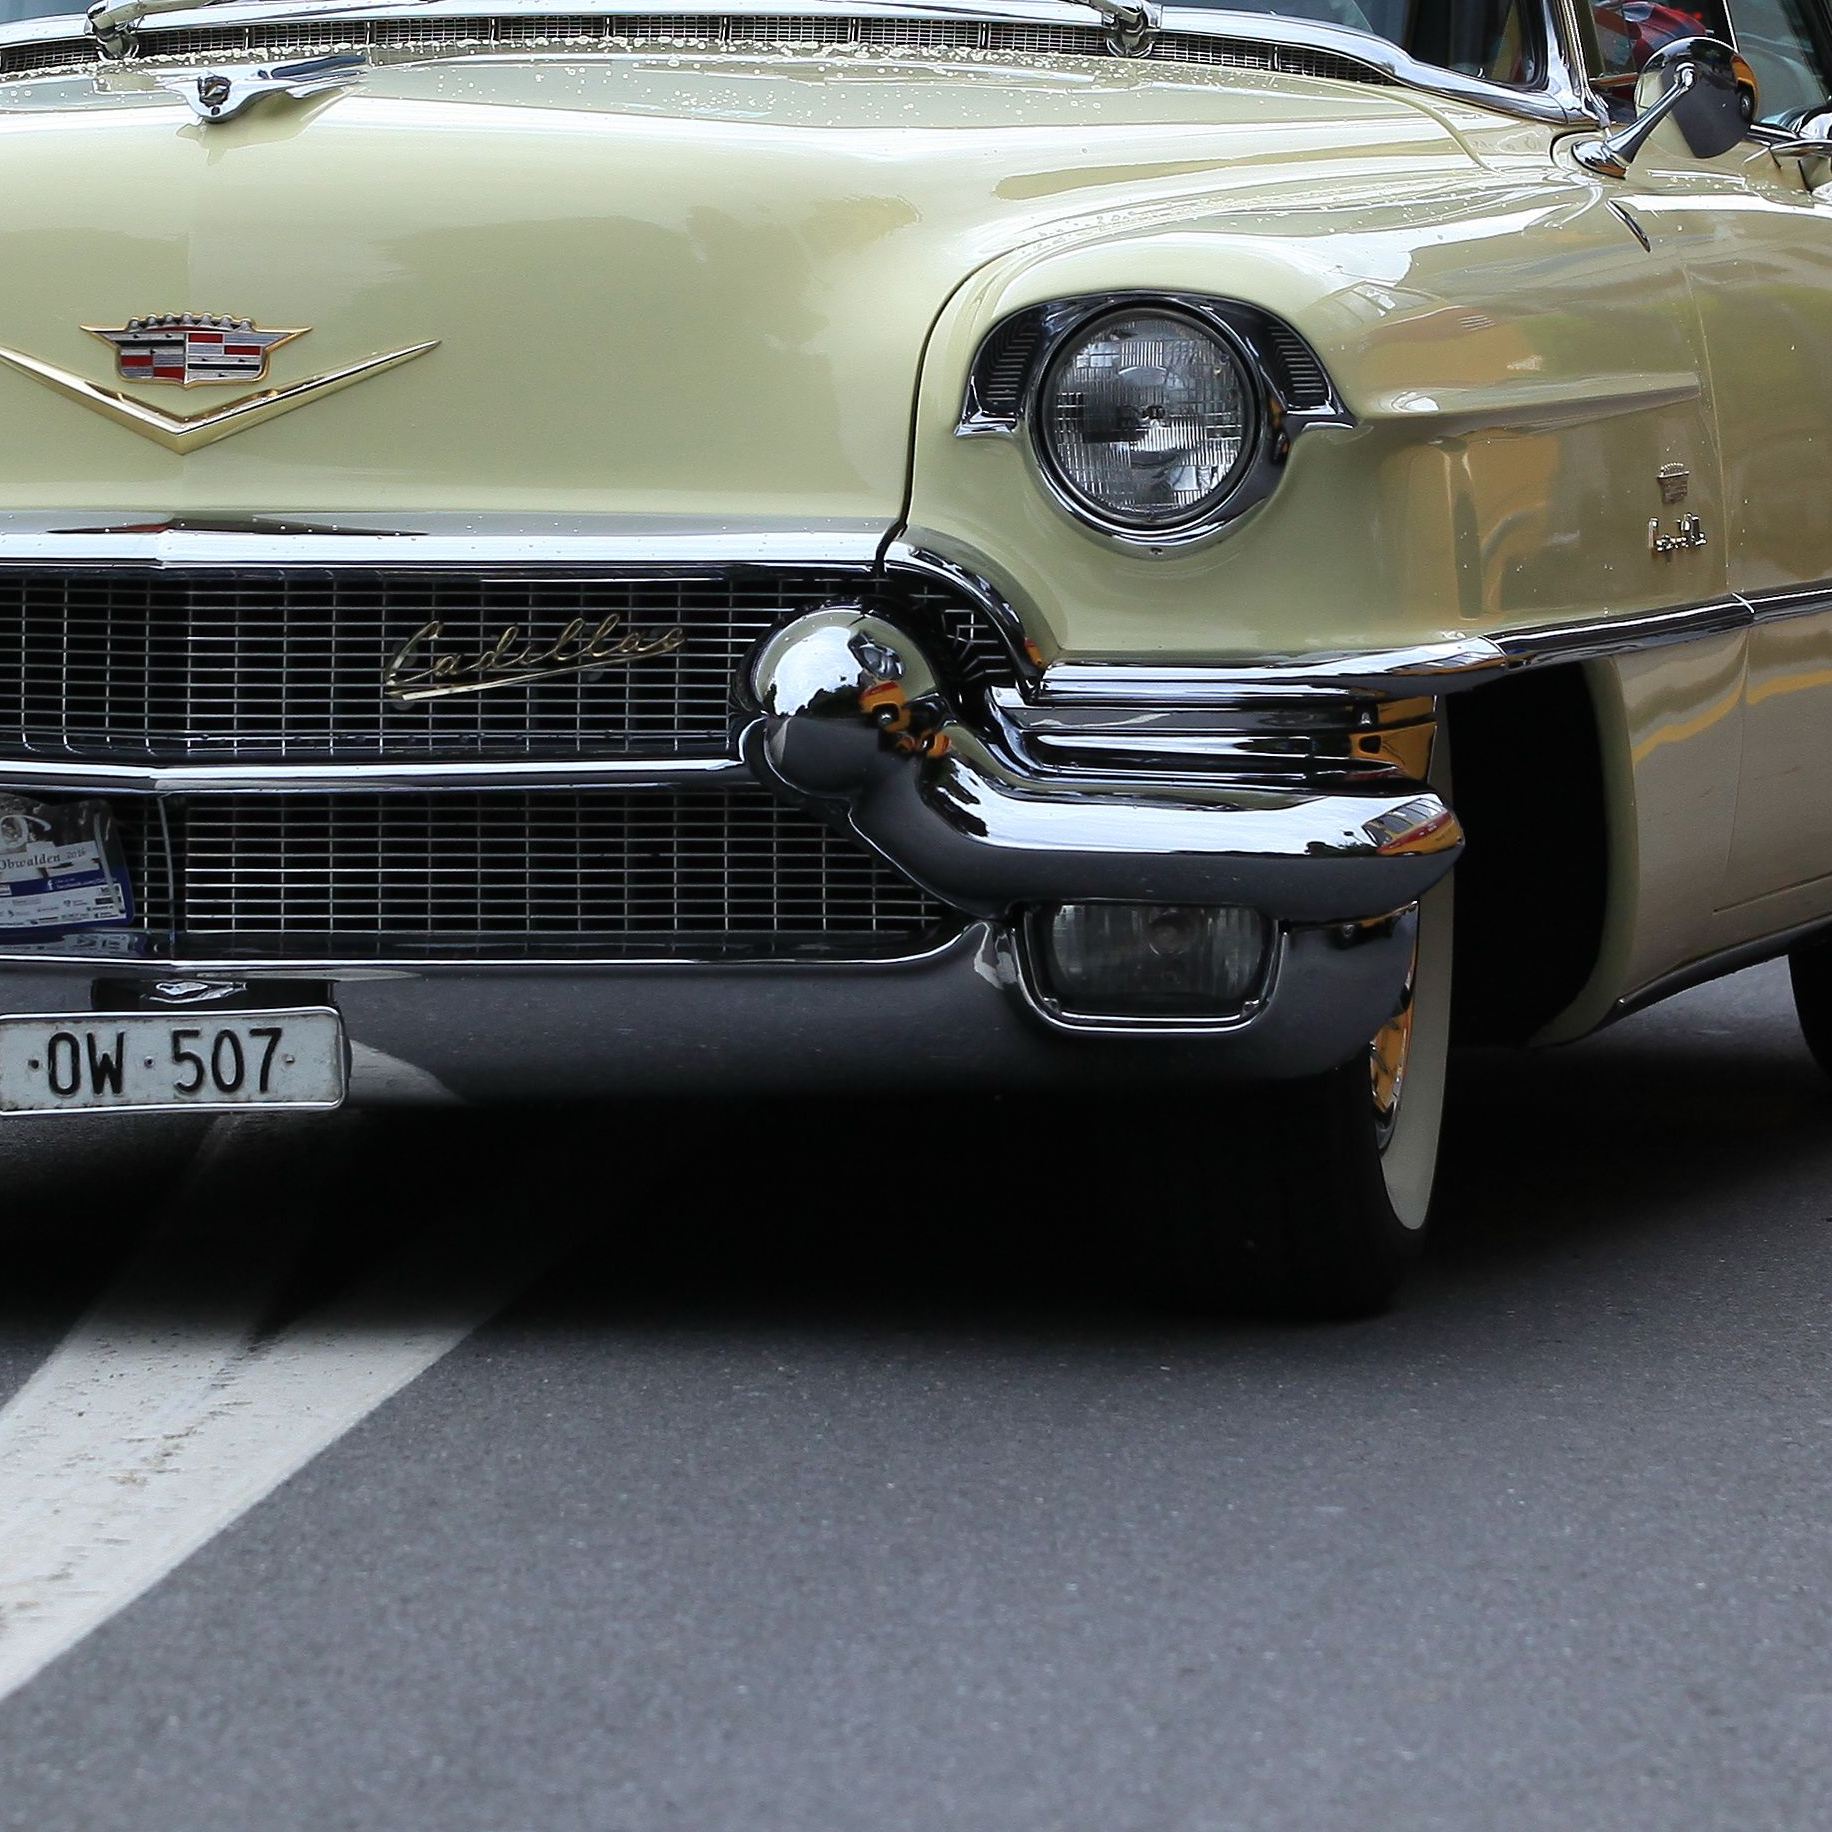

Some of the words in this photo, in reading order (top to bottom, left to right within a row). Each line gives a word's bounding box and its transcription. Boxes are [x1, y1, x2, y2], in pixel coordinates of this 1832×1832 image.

[384, 613, 687, 688] Cadillac
[48, 1029, 125, 1096] OW
[171, 1026, 283, 1094] 507
